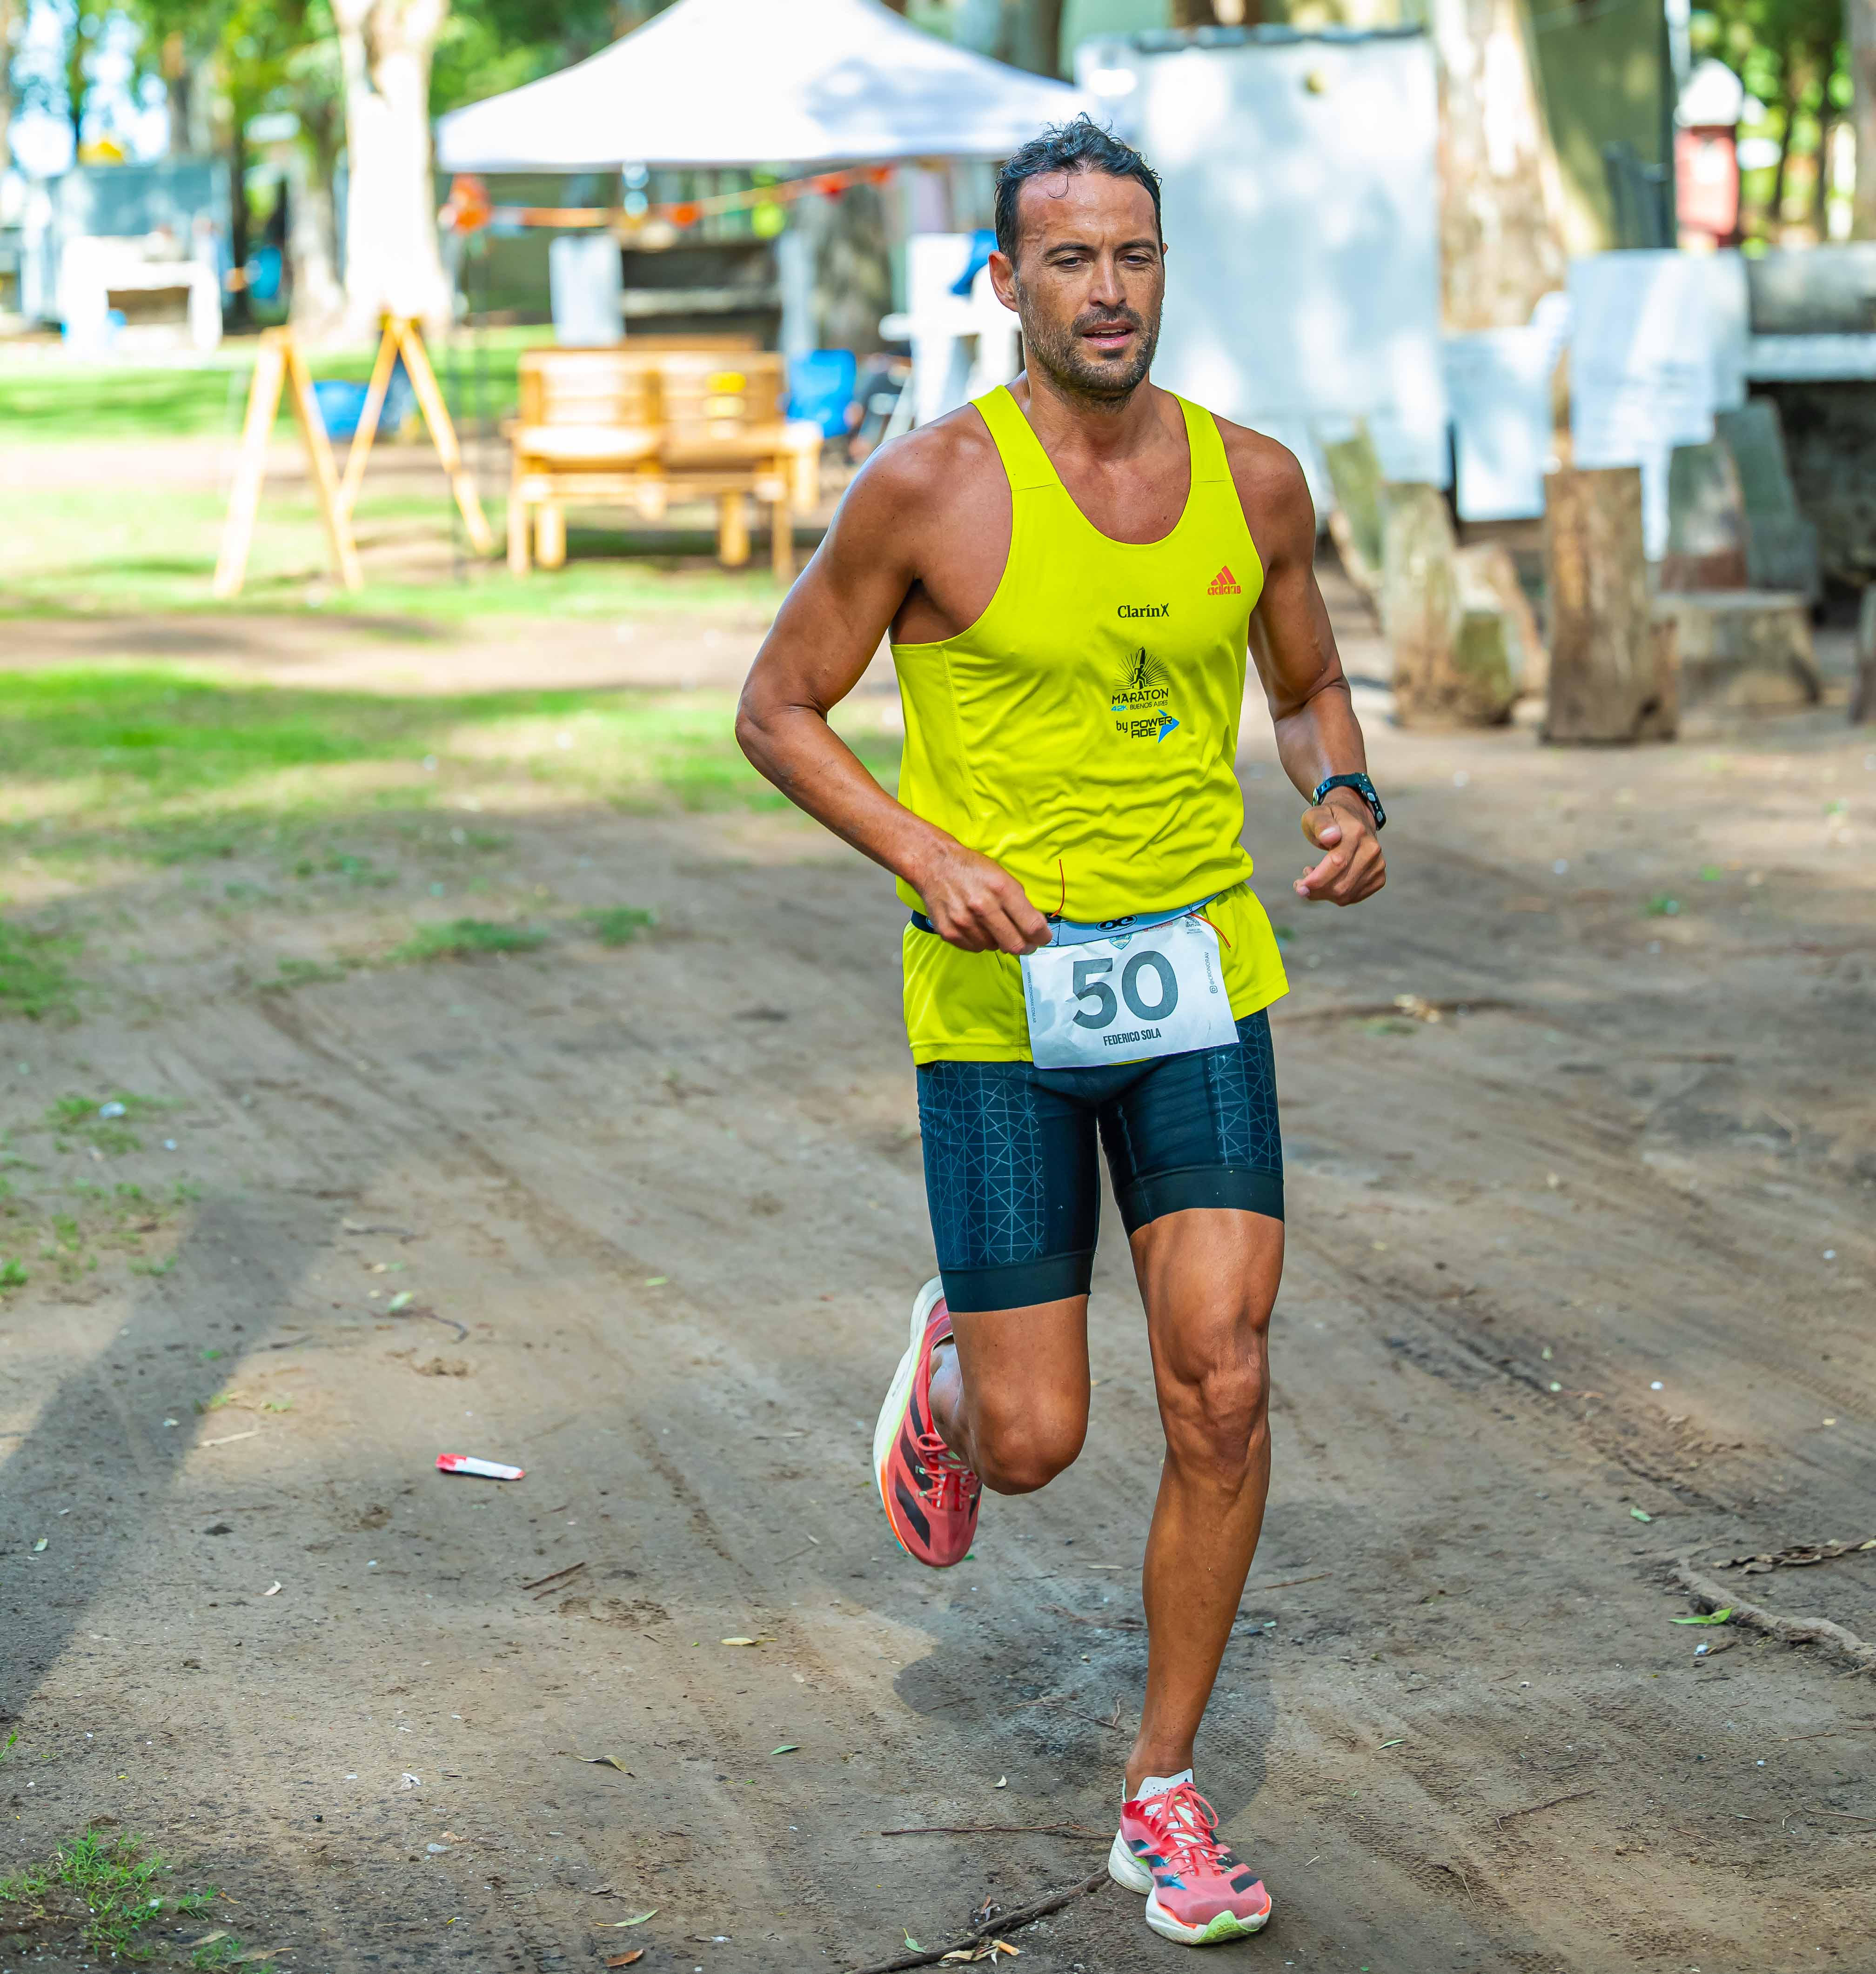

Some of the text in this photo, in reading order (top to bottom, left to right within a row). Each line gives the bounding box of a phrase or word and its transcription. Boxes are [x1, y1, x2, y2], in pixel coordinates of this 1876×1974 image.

[1112, 688, 1168, 704] MARATON
[1130, 702, 1152, 710] BUENOS
[1116, 716, 1172, 733] by POWER
[1131, 727, 1157, 738] ADE
[1204, 952, 1214, 985] @CRONORAV
[1072, 951, 1178, 1029] 50
[1103, 1028, 1161, 1046] FEDERICO SOLA
